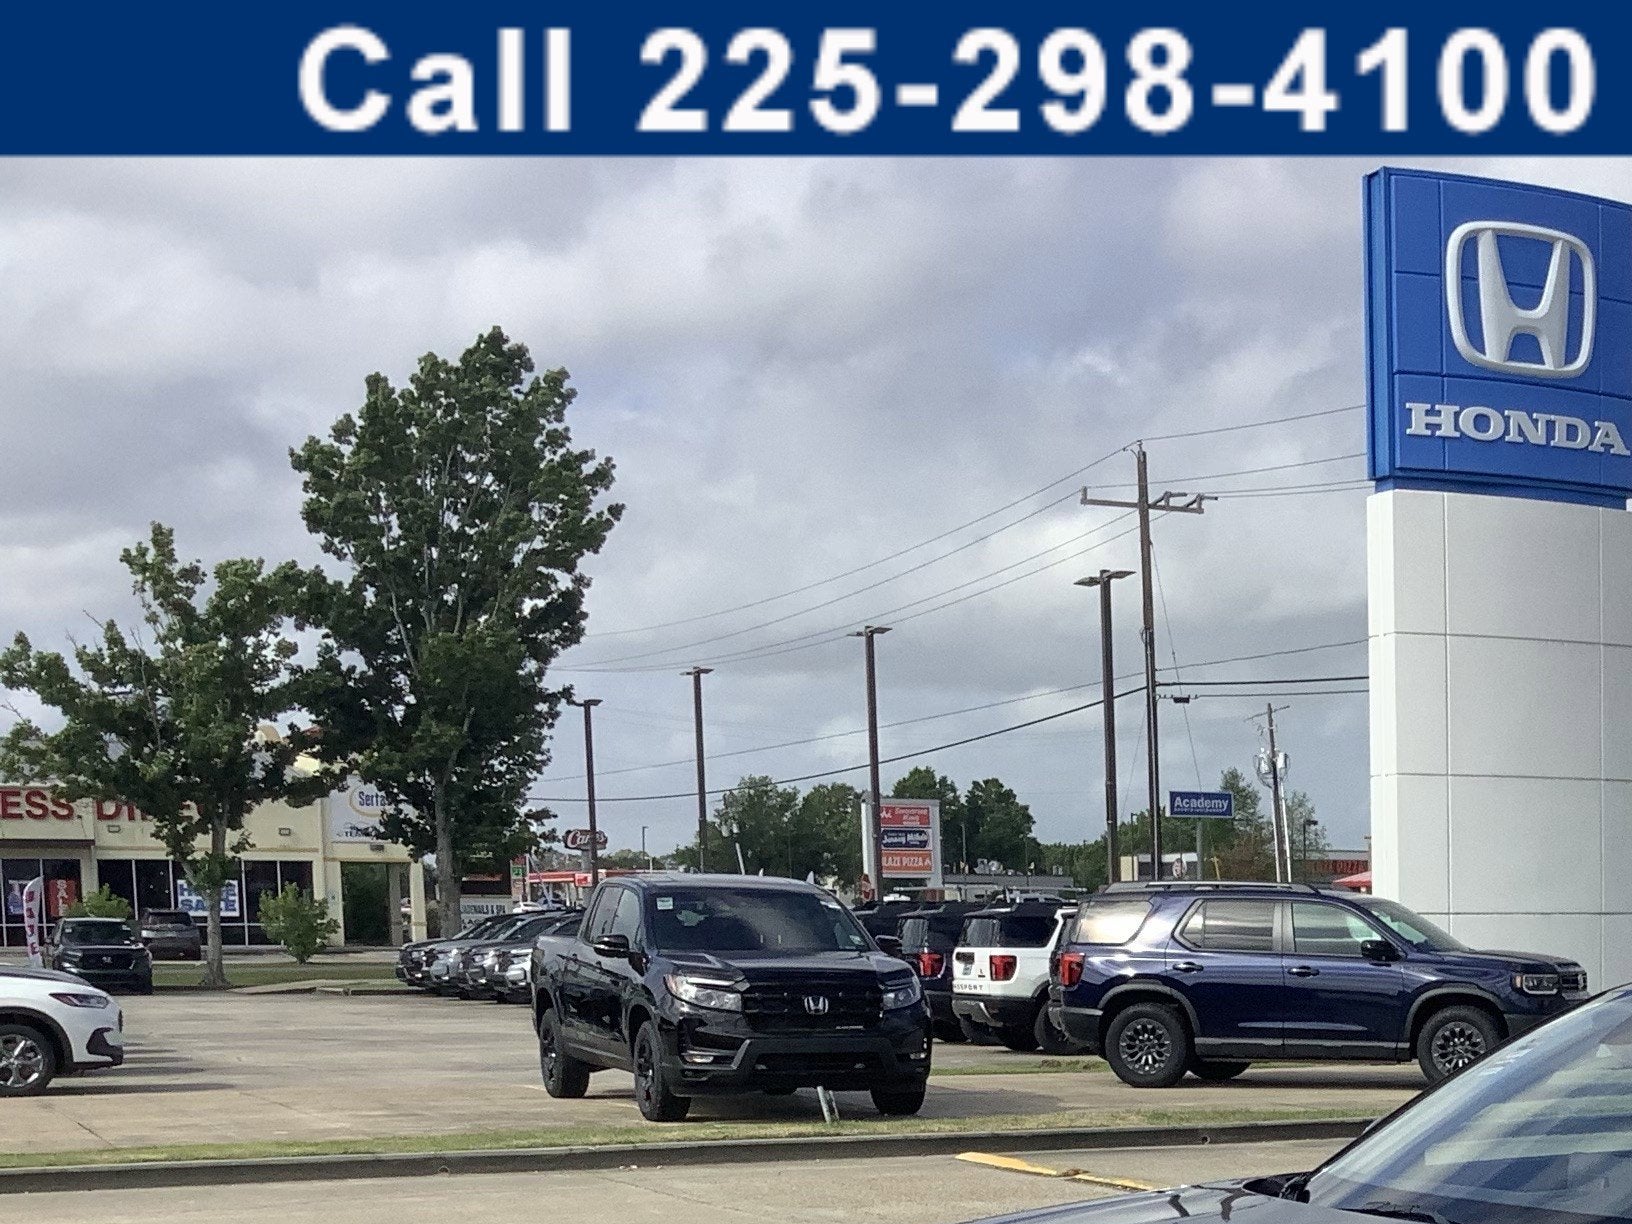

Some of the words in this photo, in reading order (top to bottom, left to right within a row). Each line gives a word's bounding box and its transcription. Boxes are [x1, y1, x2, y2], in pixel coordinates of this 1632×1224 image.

[1405, 402, 1631, 456] HONDA
[358, 791, 386, 807] Serta
[1174, 796, 1229, 812] Academy
[180, 898, 237, 912] SAE
